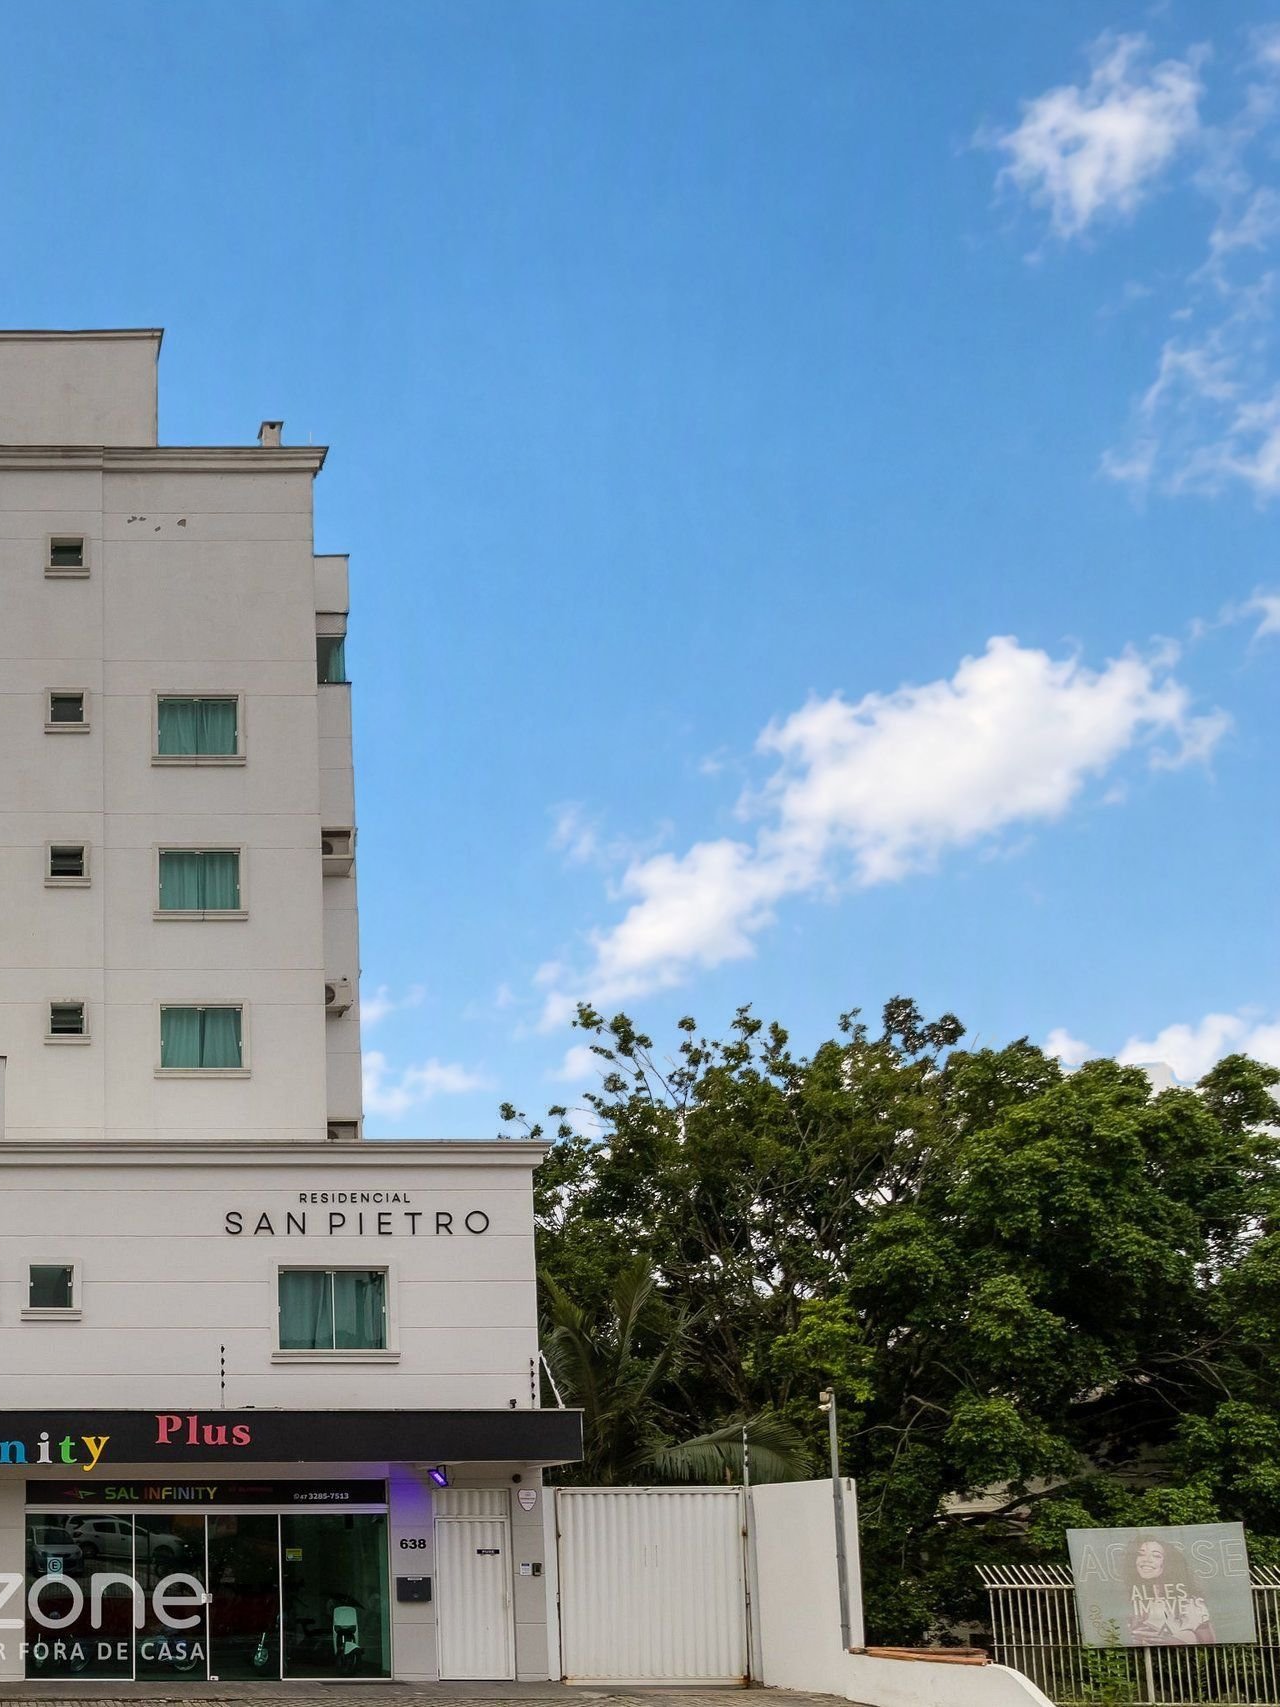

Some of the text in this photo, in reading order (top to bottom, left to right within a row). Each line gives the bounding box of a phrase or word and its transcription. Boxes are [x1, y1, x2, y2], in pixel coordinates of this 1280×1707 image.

[299, 1192, 411, 1204] RESIDENCIAL
[224, 1210, 490, 1235] SAN PIETRO
[155, 1414, 252, 1447] Plus
[105, 1487, 139, 1499] SAL
[144, 1487, 217, 1499] INFINITY
[399, 1539, 427, 1549] 638
[1079, 1538, 1250, 1582] ACSE
[1131, 1583, 1188, 1600] ALLES
